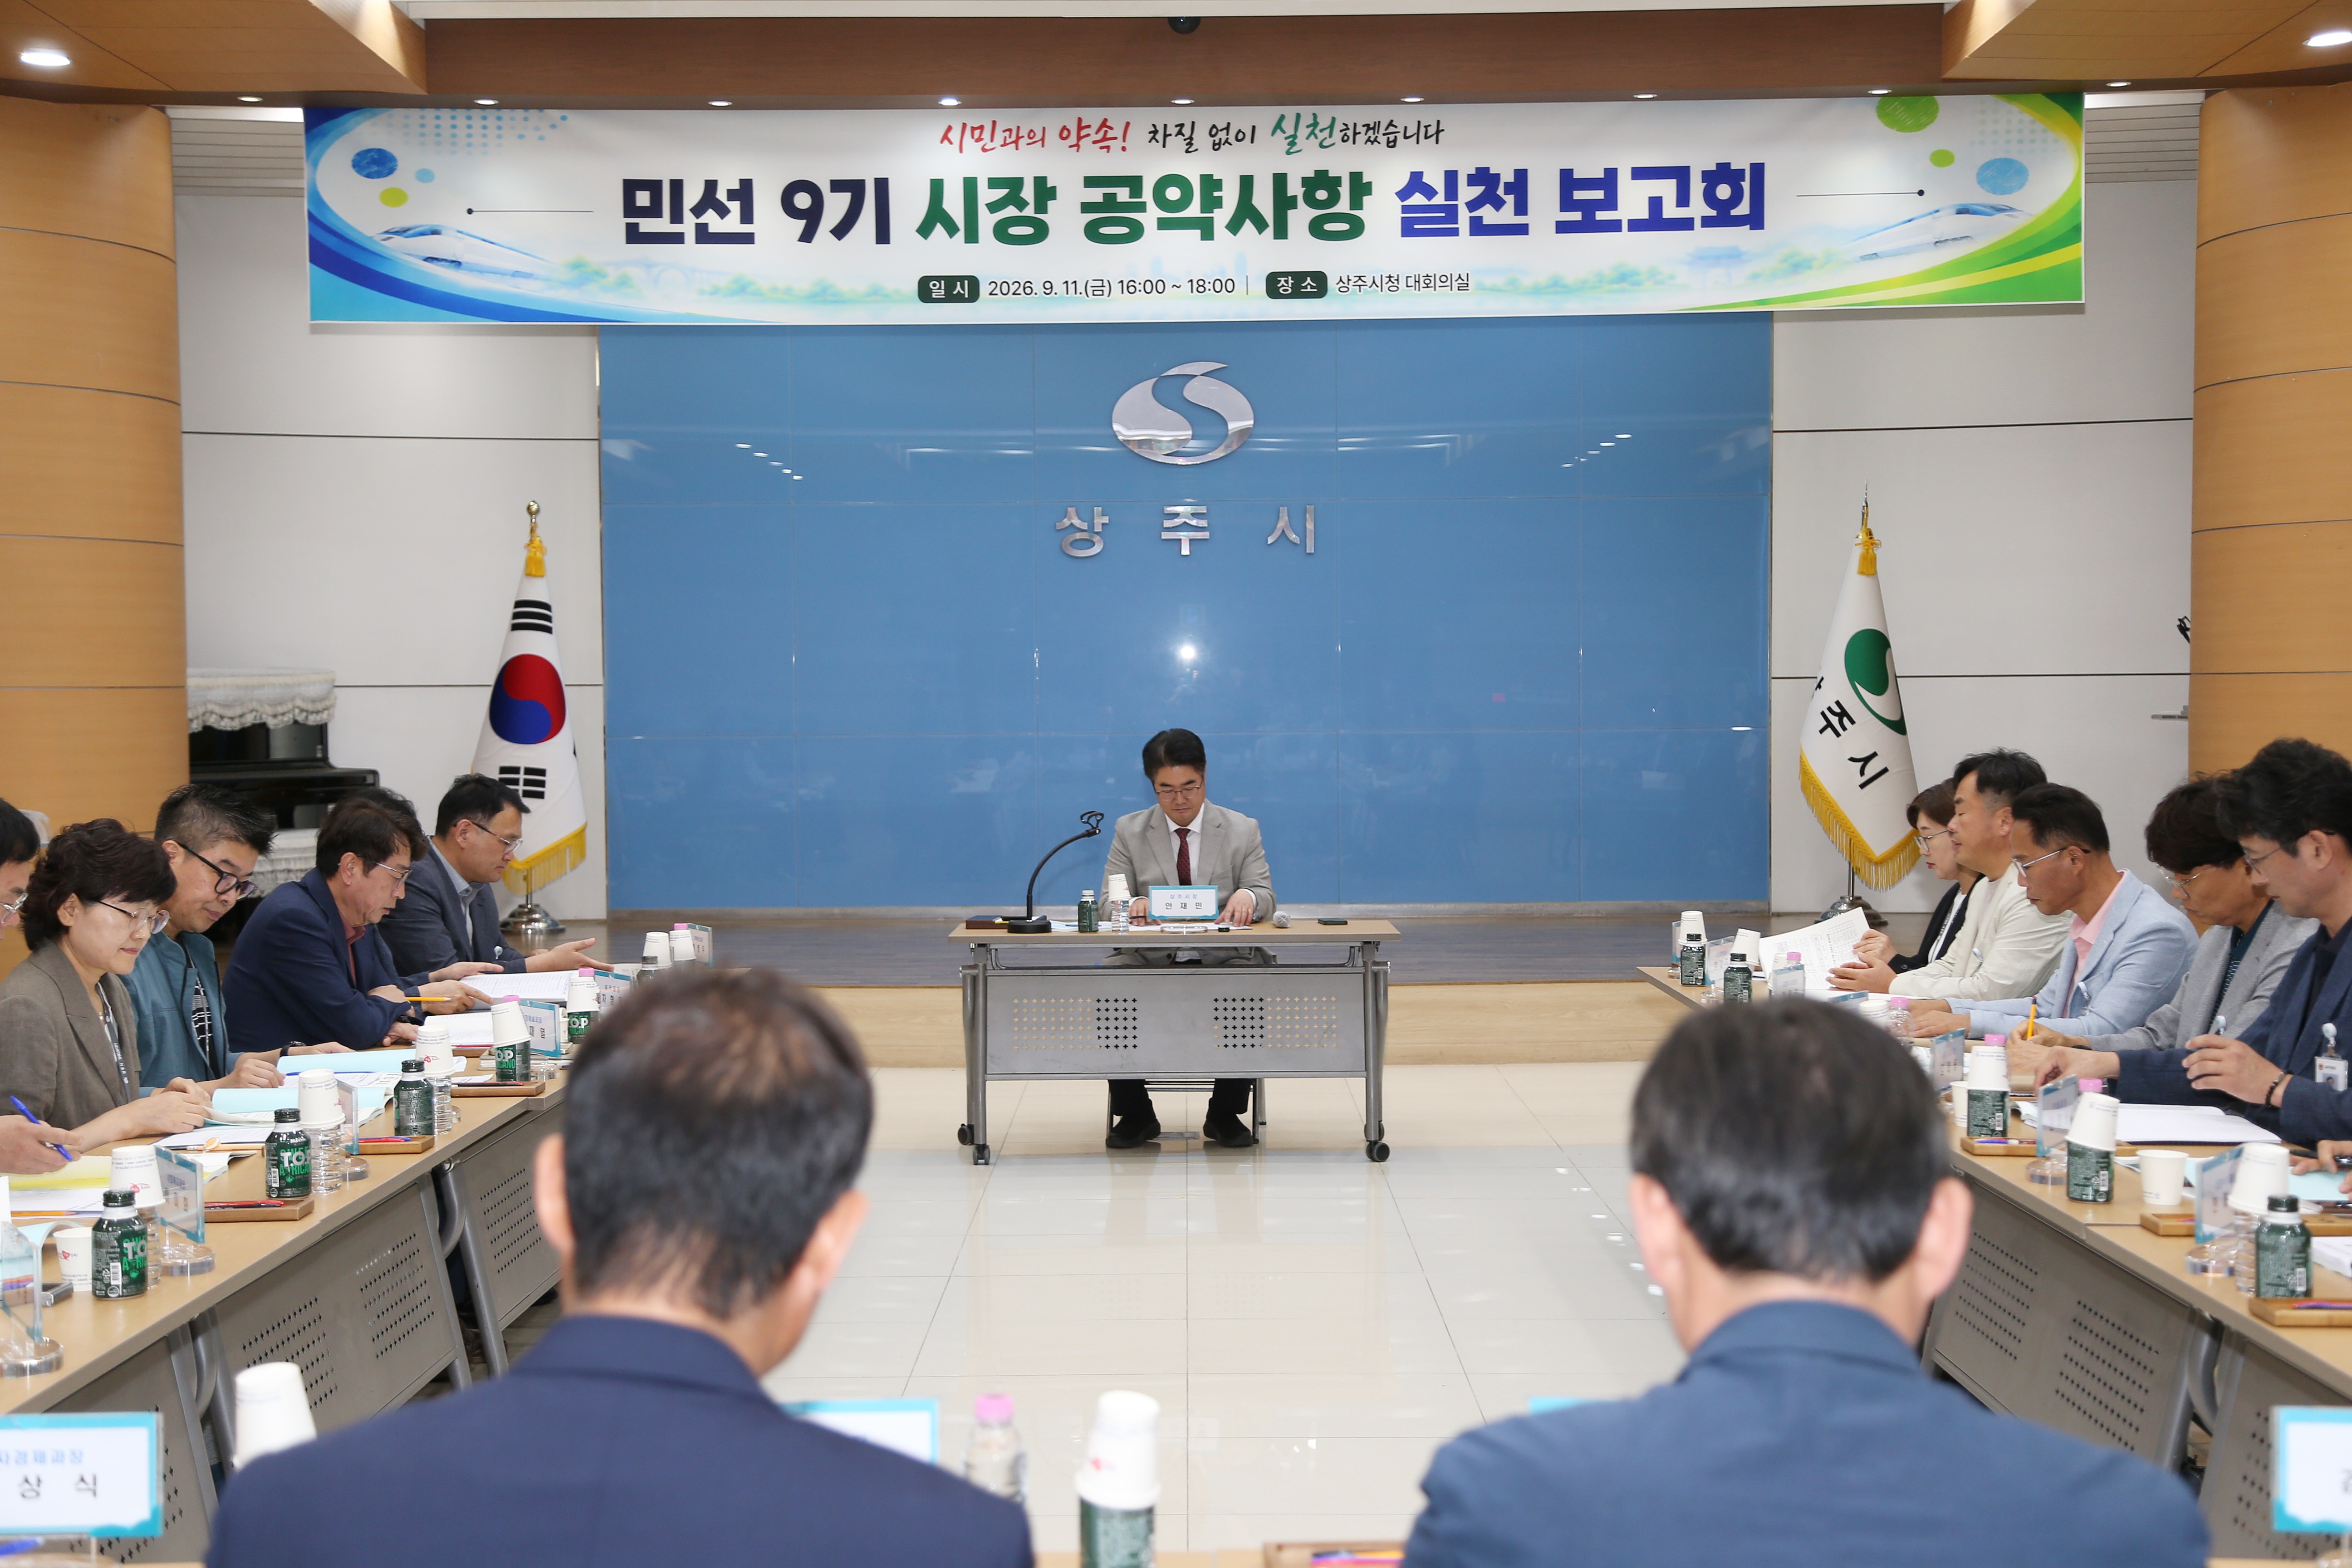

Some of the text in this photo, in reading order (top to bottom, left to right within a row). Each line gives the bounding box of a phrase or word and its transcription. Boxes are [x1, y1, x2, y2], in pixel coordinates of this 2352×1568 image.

[941, 112, 1446, 156] 시민과의 약속! 차질 없이 실천하겠습니다
[622, 162, 1766, 246] 민선 9기 시장 공약사항 실천 보고회
[929, 280, 969, 298] 일시
[1118, 279, 1166, 295] 16:00
[1188, 278, 1236, 294] 18:00
[1276, 273, 1470, 295] 장소 상주시청 대회의실
[1815, 676, 1890, 790] 주시
